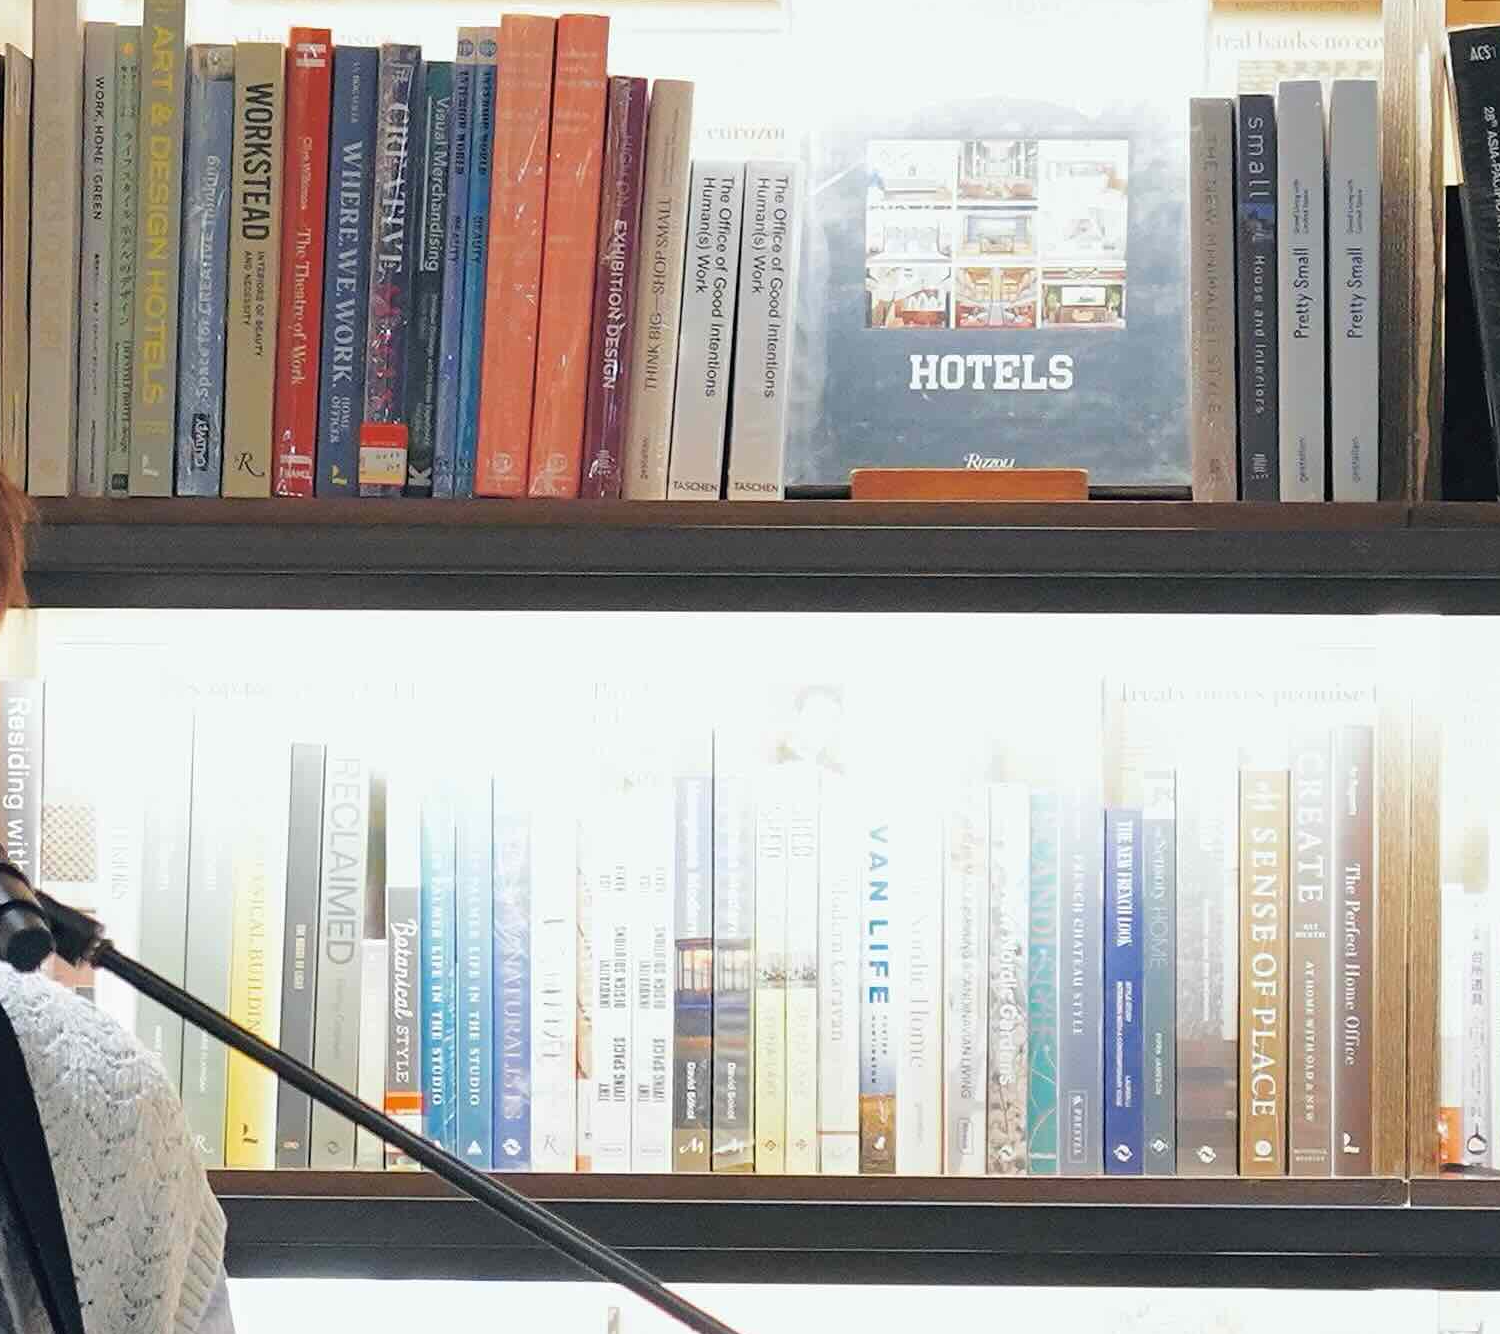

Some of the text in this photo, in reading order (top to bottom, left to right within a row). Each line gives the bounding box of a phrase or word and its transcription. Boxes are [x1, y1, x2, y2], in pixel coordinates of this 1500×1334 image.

[140, 26, 175, 406] ART & DESIGN HOTELS
[243, 83, 275, 241] WORKSTEAD
[424, 96, 450, 271] Visual Merchandising
[695, 176, 716, 294] Human(s) Work
[1247, 116, 1269, 198] small
[604, 219, 628, 390] EXHIBITION DESIGN
[706, 177, 735, 398] The Office of Good Intentions
[1293, 246, 1311, 340] Pretty Small
[909, 354, 1073, 391] HOTELS
[673, 481, 718, 493] TASCHEN
[3, 697, 32, 810] Residing
[325, 756, 359, 965] RECLAIMED
[869, 826, 888, 1004] VAN LIFE
[392, 919, 418, 1084] Botanical STYLE
[1251, 827, 1277, 1117] SENSE OF PLACE
[1344, 864, 1360, 1066] The Perfect Home Office
